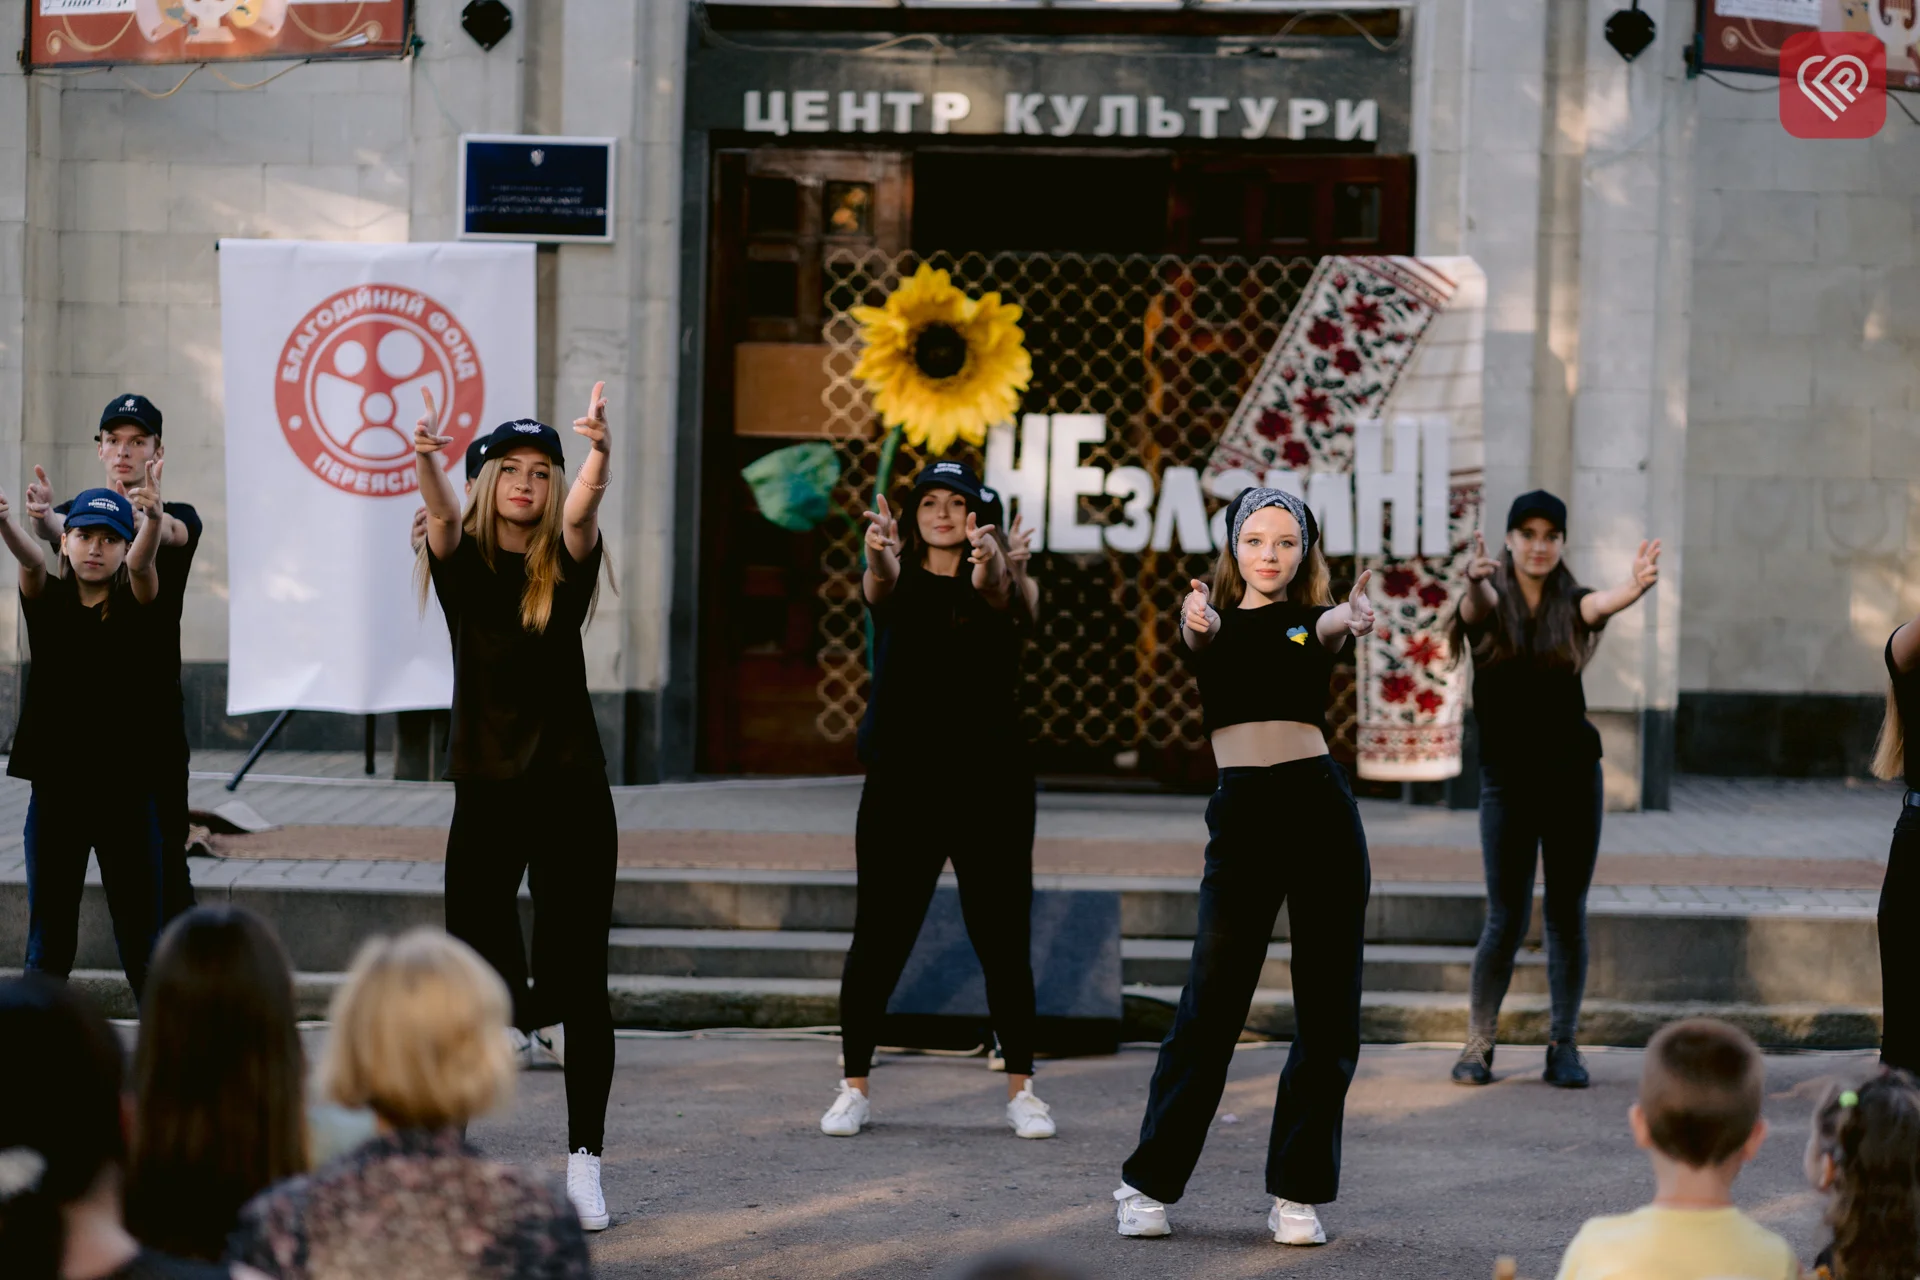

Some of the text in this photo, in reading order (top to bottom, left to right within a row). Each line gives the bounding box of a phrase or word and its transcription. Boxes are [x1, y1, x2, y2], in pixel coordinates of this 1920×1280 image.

[743, 90, 1379, 142] ЦЕНТР КУЛЬТУРИ
[281, 286, 478, 383] БЛАГОДІЙНИЙ ФОНД
[313, 451, 448, 494] ПЕРЕЯСЛ
